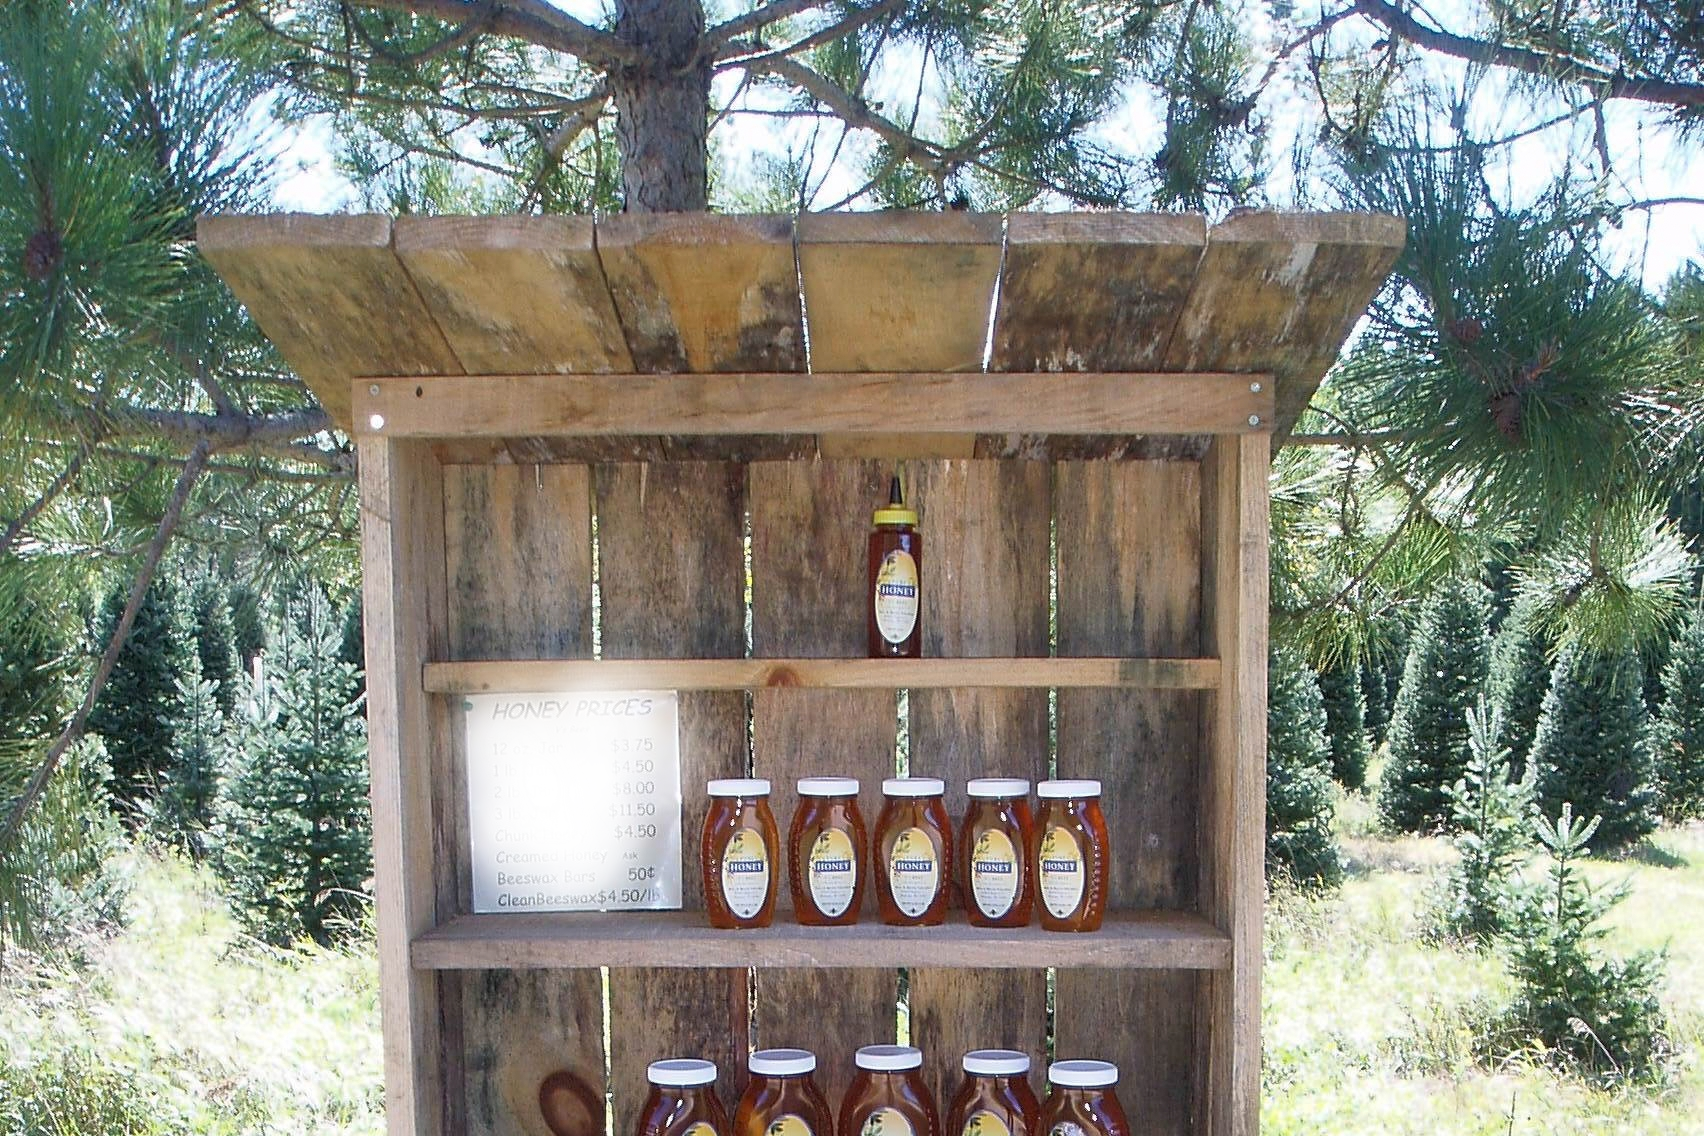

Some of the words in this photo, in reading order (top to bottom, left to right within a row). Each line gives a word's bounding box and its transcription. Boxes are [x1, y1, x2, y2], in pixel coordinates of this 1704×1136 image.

[881, 585, 914, 597] HONEY
[492, 701, 569, 720] HONEY
[575, 697, 654, 717] PRICES
[493, 742, 508, 756] 12
[611, 737, 653, 754] $3.75
[612, 759, 654, 775] $4.50
[612, 781, 655, 797] $8.00
[609, 803, 656, 819] $11.50
[614, 824, 657, 841] $4.50
[496, 850, 559, 864] Creamed
[730, 861, 762, 872] HONEY
[817, 861, 849, 872] HONEY
[897, 861, 931, 871] HONEY
[976, 862, 1010, 873] HONEY
[1044, 861, 1075, 872] HONEY
[497, 870, 558, 886] Beeswax
[564, 868, 596, 883] Bars
[628, 866, 656, 881] 50¢
